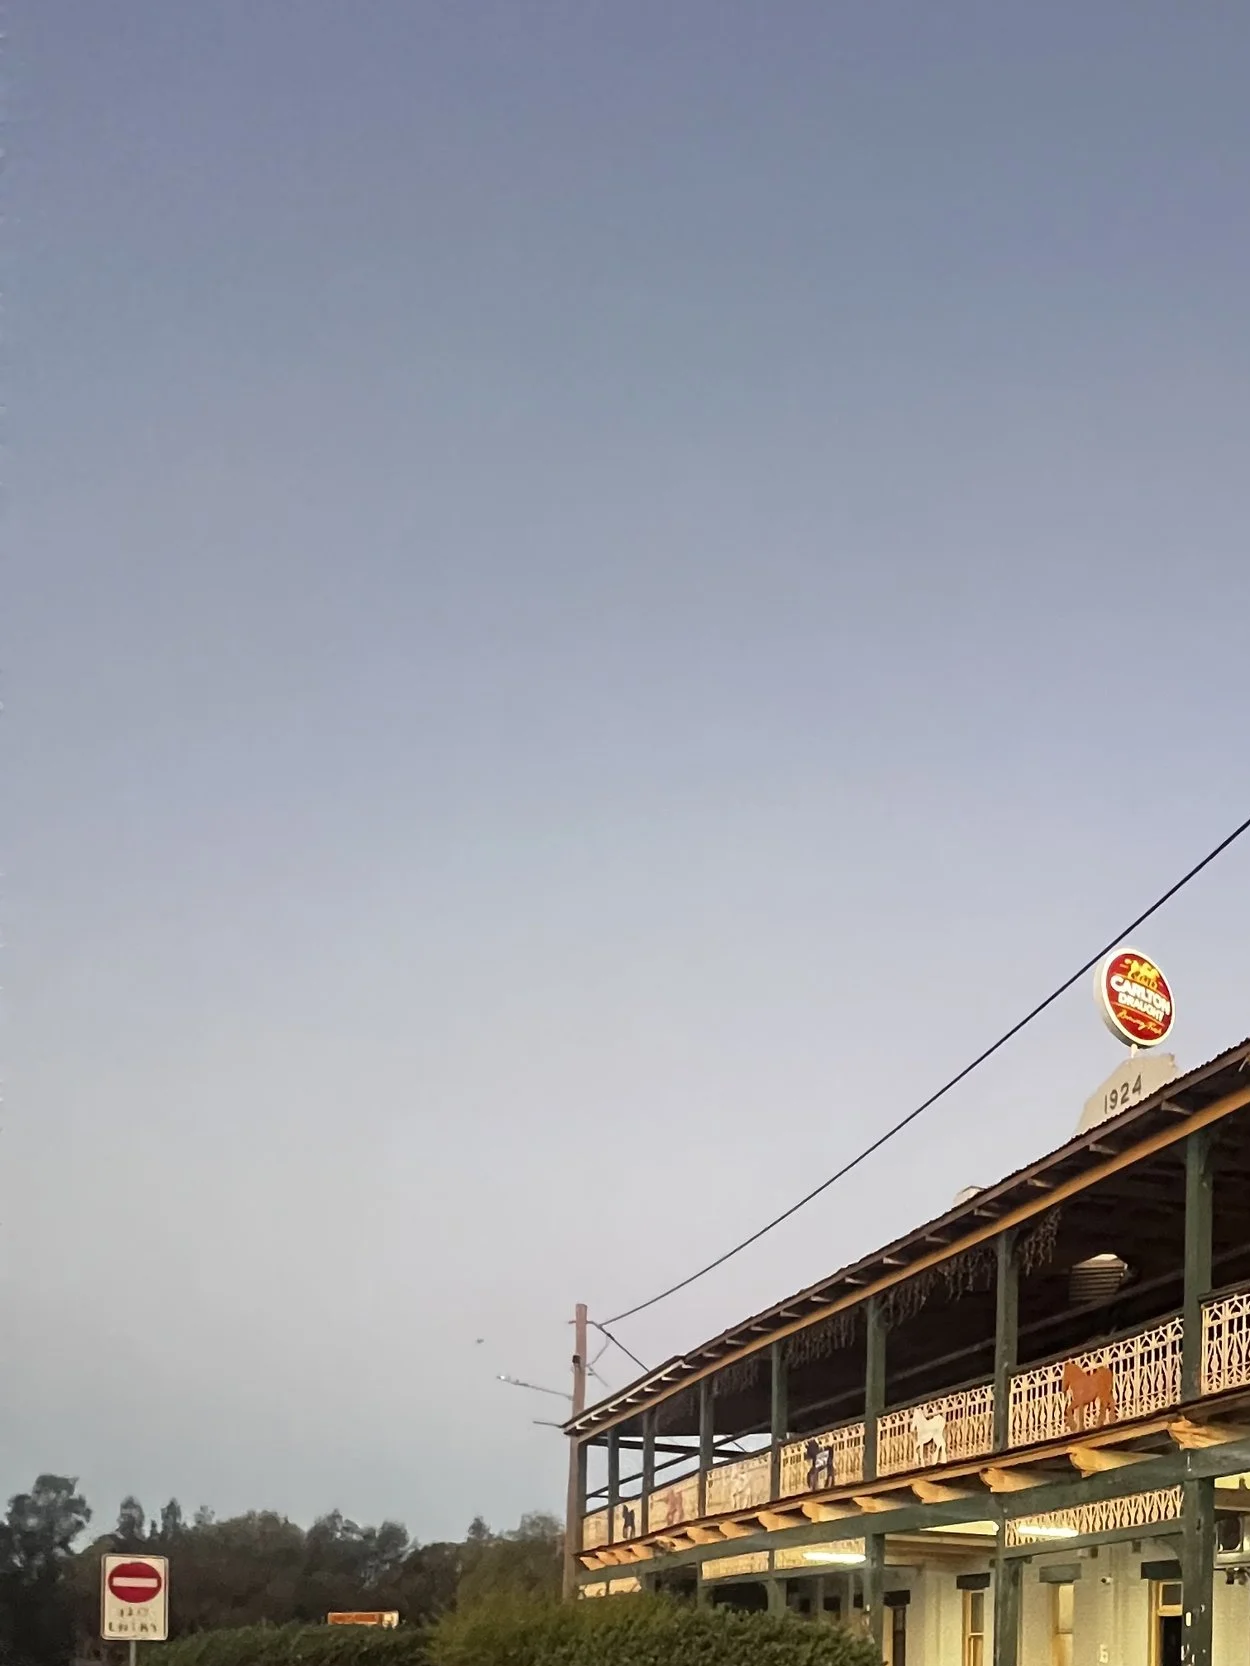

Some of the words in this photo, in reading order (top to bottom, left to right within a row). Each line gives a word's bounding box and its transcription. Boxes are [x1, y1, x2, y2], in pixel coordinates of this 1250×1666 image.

[1110, 975, 1171, 1016] CARLTON
[1118, 991, 1165, 1022] DRAUGHT
[1104, 1073, 1142, 1114] 1924
